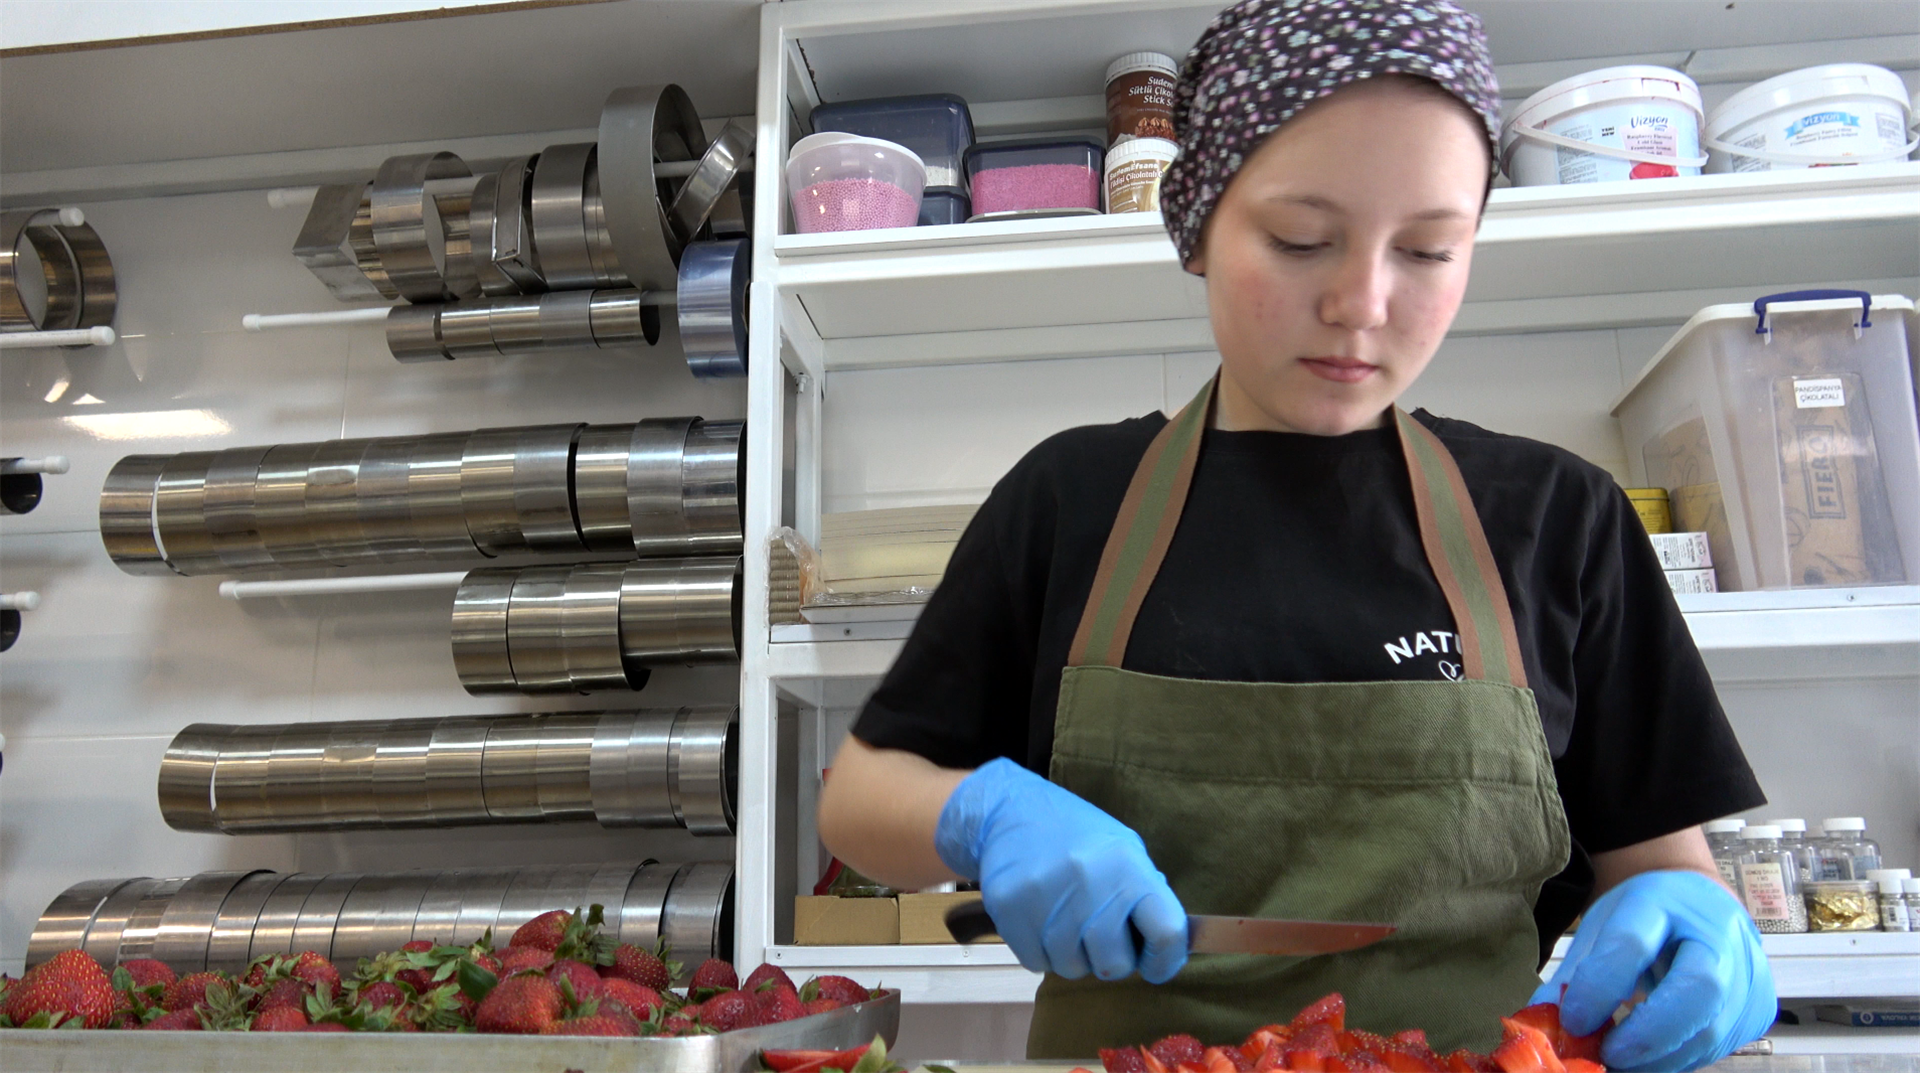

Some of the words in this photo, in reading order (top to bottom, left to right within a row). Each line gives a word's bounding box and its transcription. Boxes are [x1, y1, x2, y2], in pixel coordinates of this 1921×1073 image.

[1129, 86, 1152, 96] Sütlü
[1143, 95, 1165, 105] Stick
[1631, 115, 1668, 128] Vizyon
